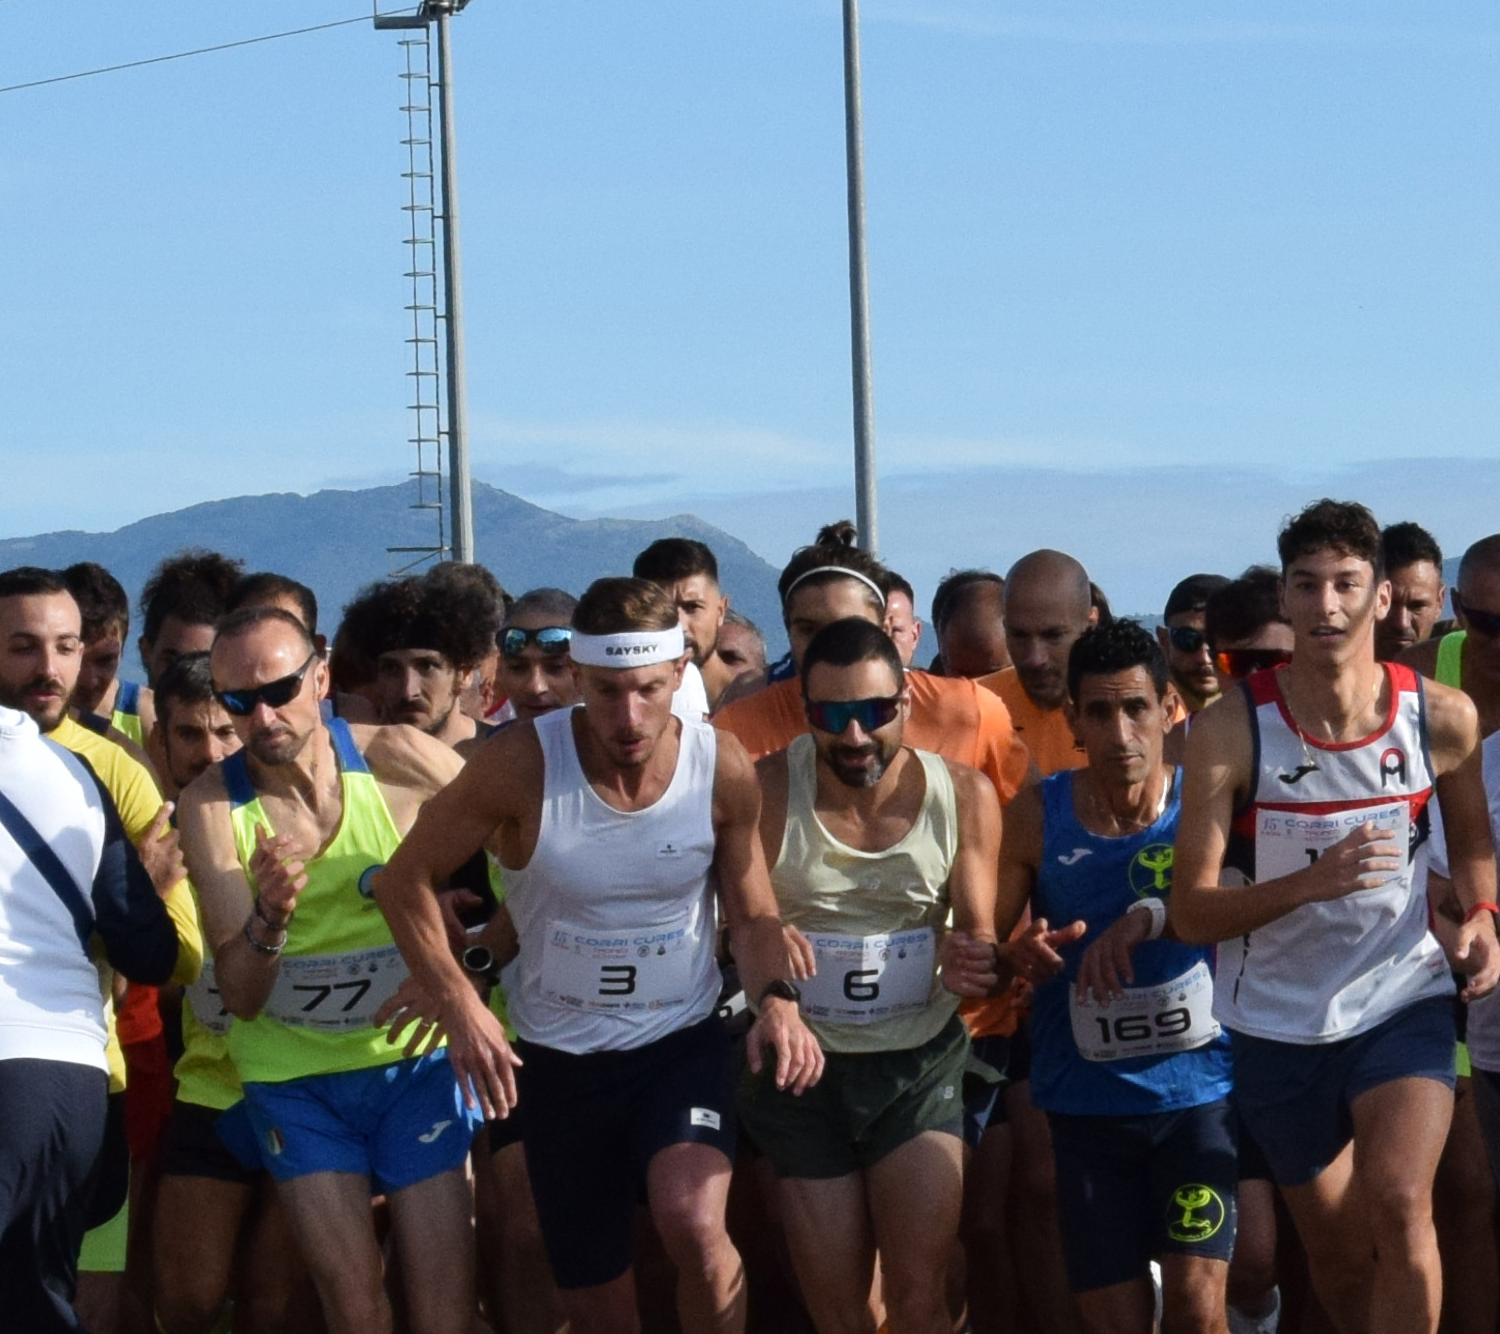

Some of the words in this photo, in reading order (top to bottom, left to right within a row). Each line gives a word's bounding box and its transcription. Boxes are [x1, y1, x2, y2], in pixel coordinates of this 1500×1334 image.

[605, 644, 659, 656] SAYSKY
[1284, 819, 1339, 829] CORRI
[1344, 808, 1400, 827] CURES
[574, 935, 628, 947] CORRI
[633, 929, 685, 946] CURES
[816, 939, 869, 950] CORRI
[874, 933, 928, 948] CURES
[599, 966, 637, 995] 3
[843, 969, 880, 1002] 6
[292, 979, 372, 1012] 77
[1096, 1007, 1191, 1043] 169
